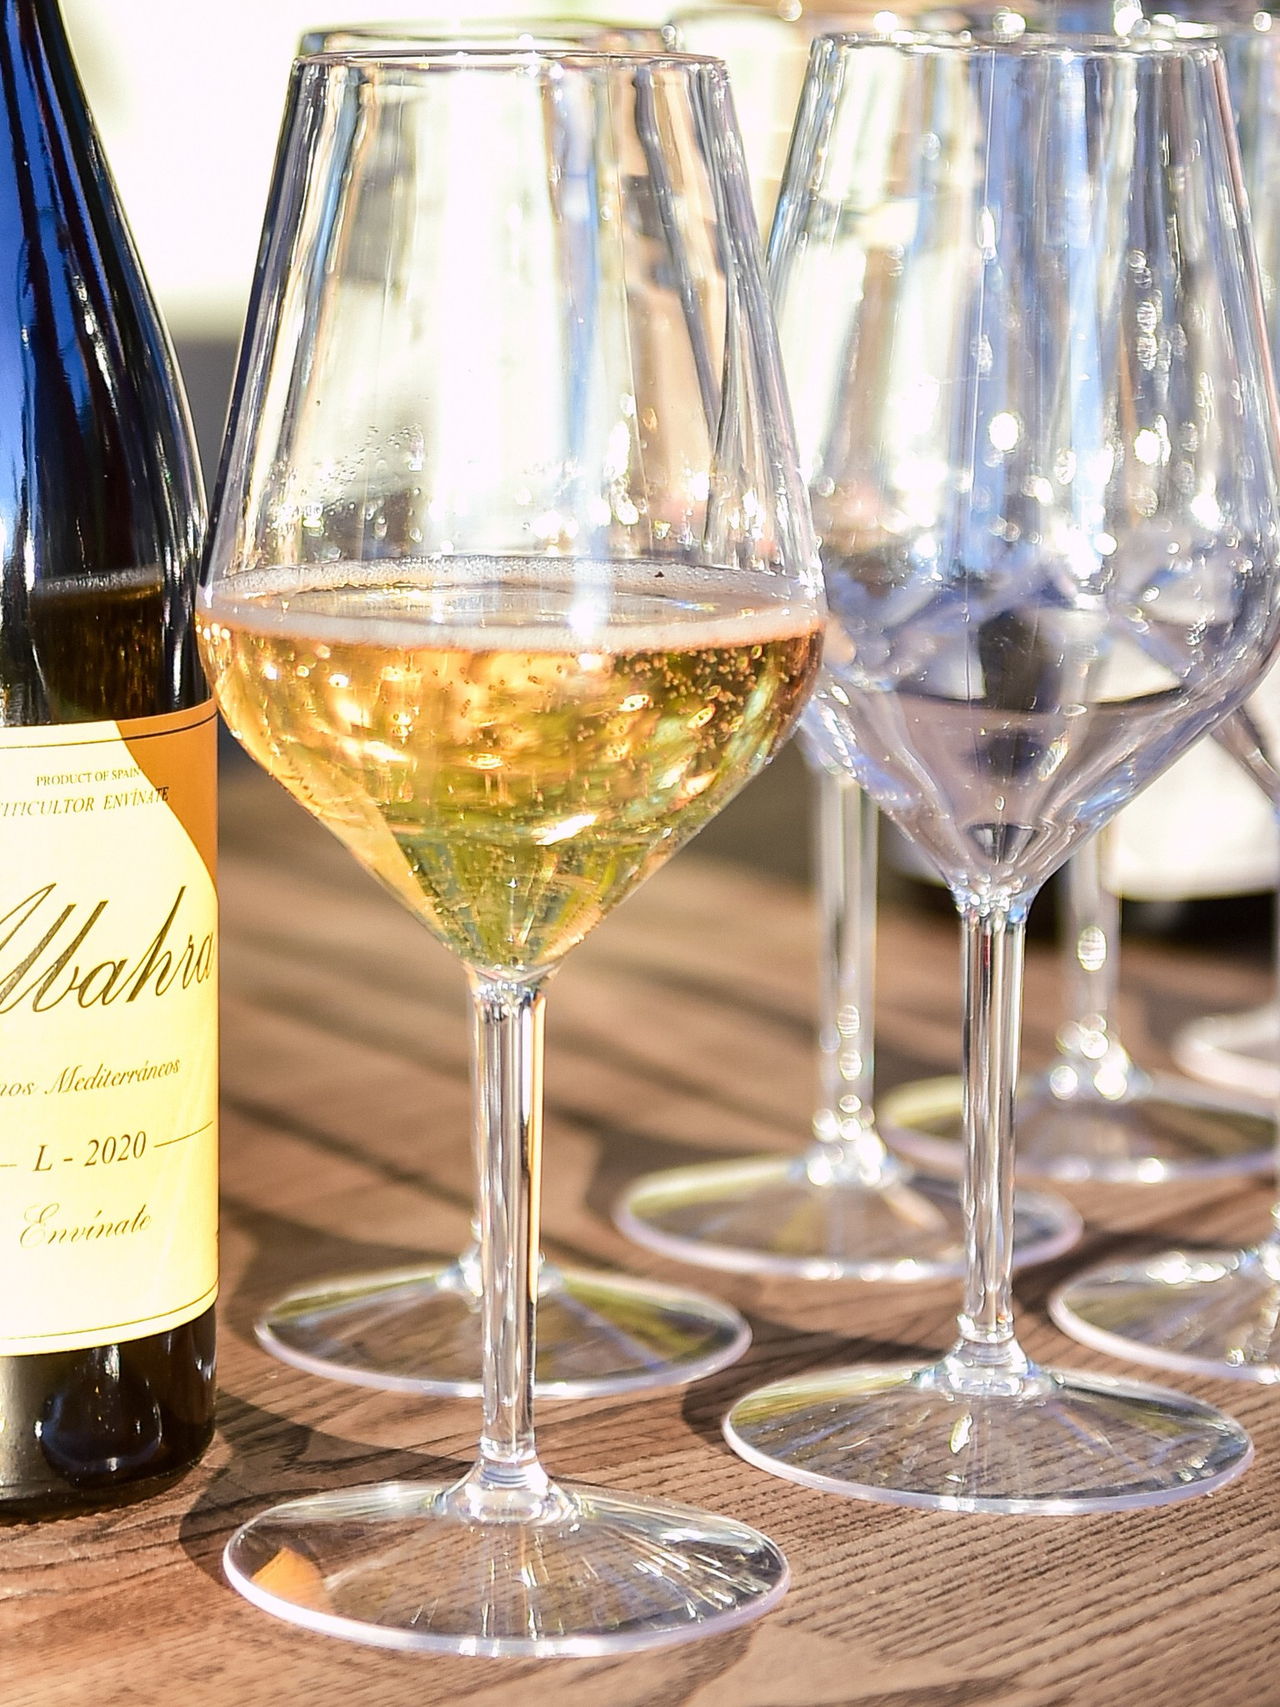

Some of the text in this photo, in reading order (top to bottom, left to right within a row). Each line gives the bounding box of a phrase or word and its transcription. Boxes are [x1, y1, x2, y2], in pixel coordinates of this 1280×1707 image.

[36, 766, 141, 787] PRODUCT OF SPAIN
[103, 786, 169, 810] ENVÍNATE
[44, 1058, 181, 1094] Mediterráneos
[32, 1144, 53, 1172] L
[84, 1130, 147, 1167] 2020
[19, 1202, 153, 1249] Envínate
